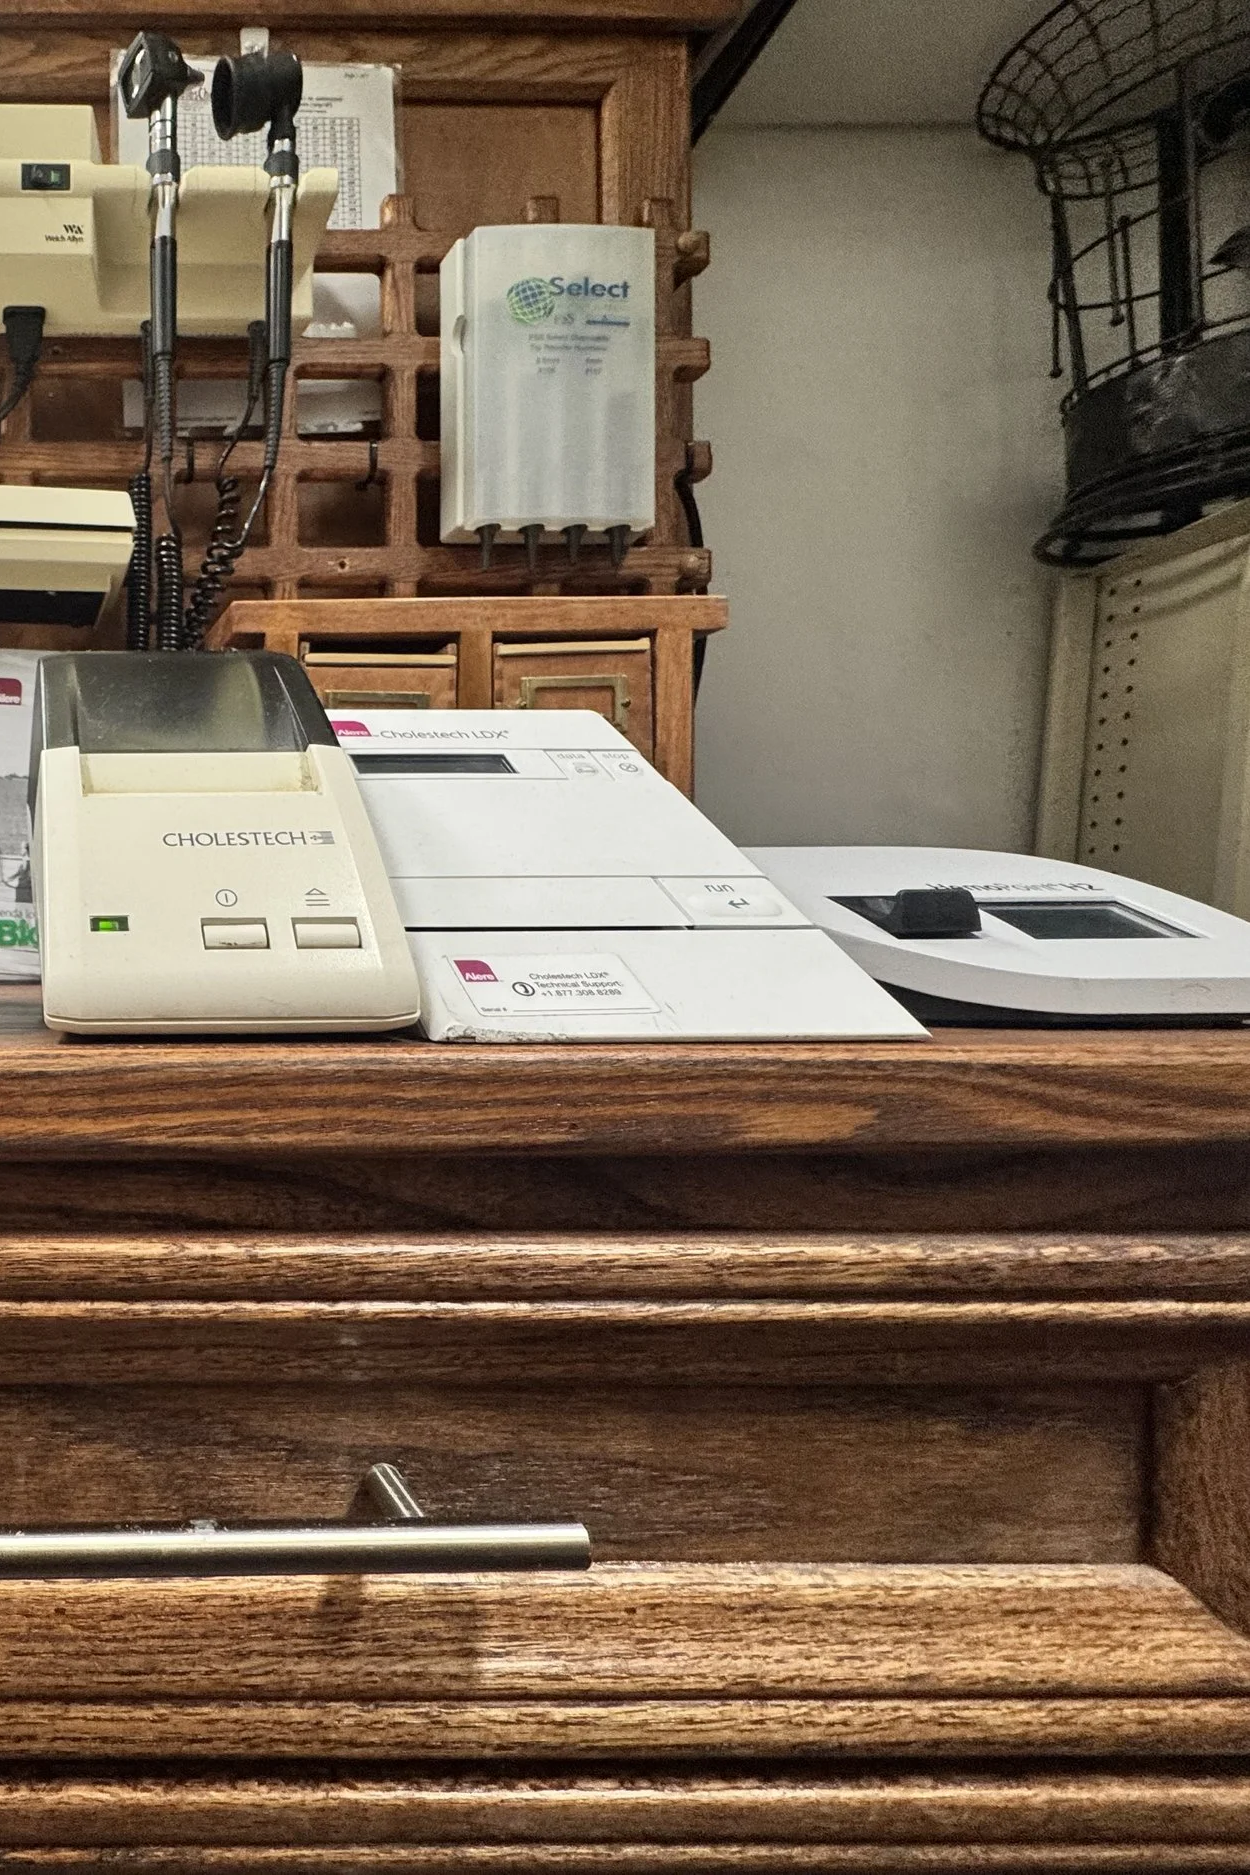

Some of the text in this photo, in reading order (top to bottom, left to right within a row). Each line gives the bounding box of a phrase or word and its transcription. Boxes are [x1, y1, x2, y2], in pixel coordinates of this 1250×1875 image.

[549, 276, 630, 299] Select
[380, 730, 470, 739] Cholestech
[602, 752, 630, 760] stop
[162, 831, 307, 847] CHOLESTECH
[704, 884, 735, 893] run
[464, 972, 495, 981] Alere
[528, 972, 583, 981] Cholestech
[533, 981, 581, 989] Technical
